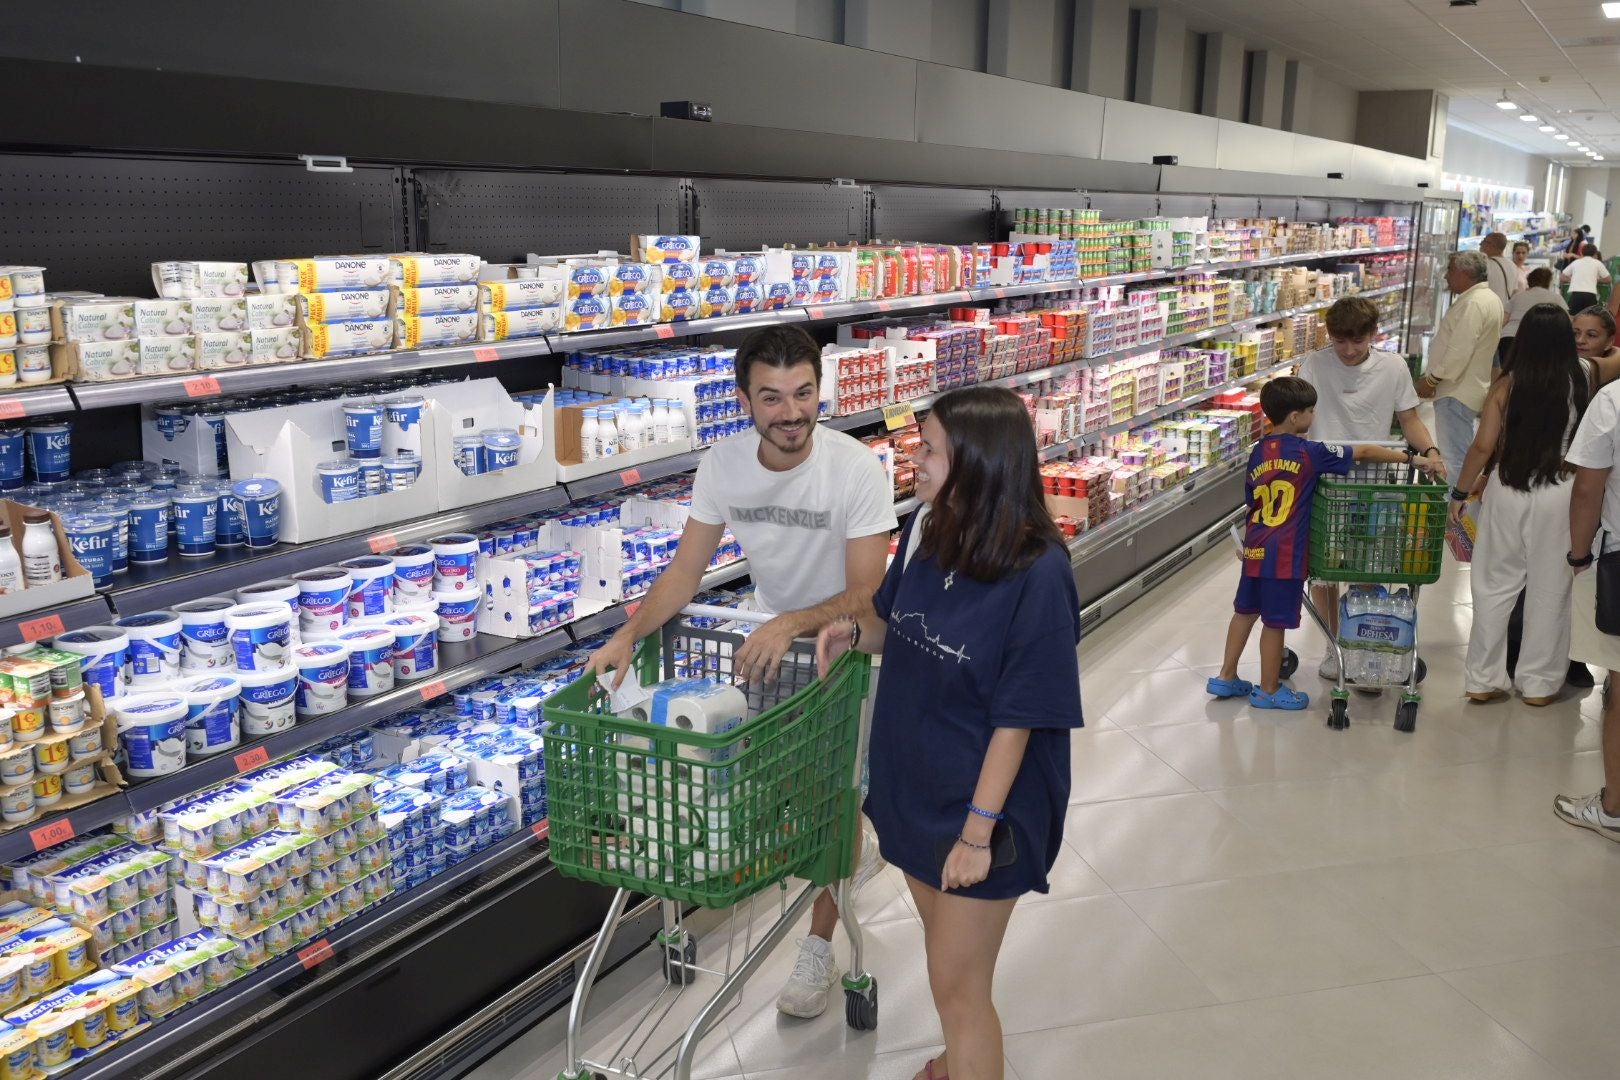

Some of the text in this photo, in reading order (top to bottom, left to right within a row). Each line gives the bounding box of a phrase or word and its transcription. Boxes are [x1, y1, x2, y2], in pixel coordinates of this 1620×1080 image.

[335, 260, 366, 270] DANONE
[434, 258, 460, 266] DANONE
[204, 270, 226, 278] Natural
[578, 275, 599, 283] GRIEGO
[341, 292, 370, 301] DANONE
[434, 287, 460, 296] DANONE
[196, 303, 222, 312] Natural
[252, 302, 275, 310] Natural
[78, 313, 107, 322] Natural
[140, 309, 167, 317] Natural
[435, 315, 460, 324] DANONE
[345, 323, 373, 332] DANONE
[256, 336, 279, 344] Natural
[85, 349, 113, 358] Natural
[145, 345, 171, 353] Natural
[346, 416, 359, 427] fir
[392, 411, 408, 422] fir
[1274, 459, 1301, 474] YAMAL
[1252, 480, 1295, 527] 10
[174, 506, 190, 518] fir
[736, 507, 826, 528] MCKENZIE
[1361, 629, 1394, 640] DEHESA
[318, 667, 344, 680] GRIEGO
[253, 688, 286, 700] GRIEGO
[252, 756, 314, 782] natural
[289, 770, 345, 800] natural
[174, 788, 240, 816] natural
[221, 832, 286, 864] natural
[69, 847, 140, 880] natural
[134, 932, 208, 968] natural
[20, 992, 78, 1022] Natural
